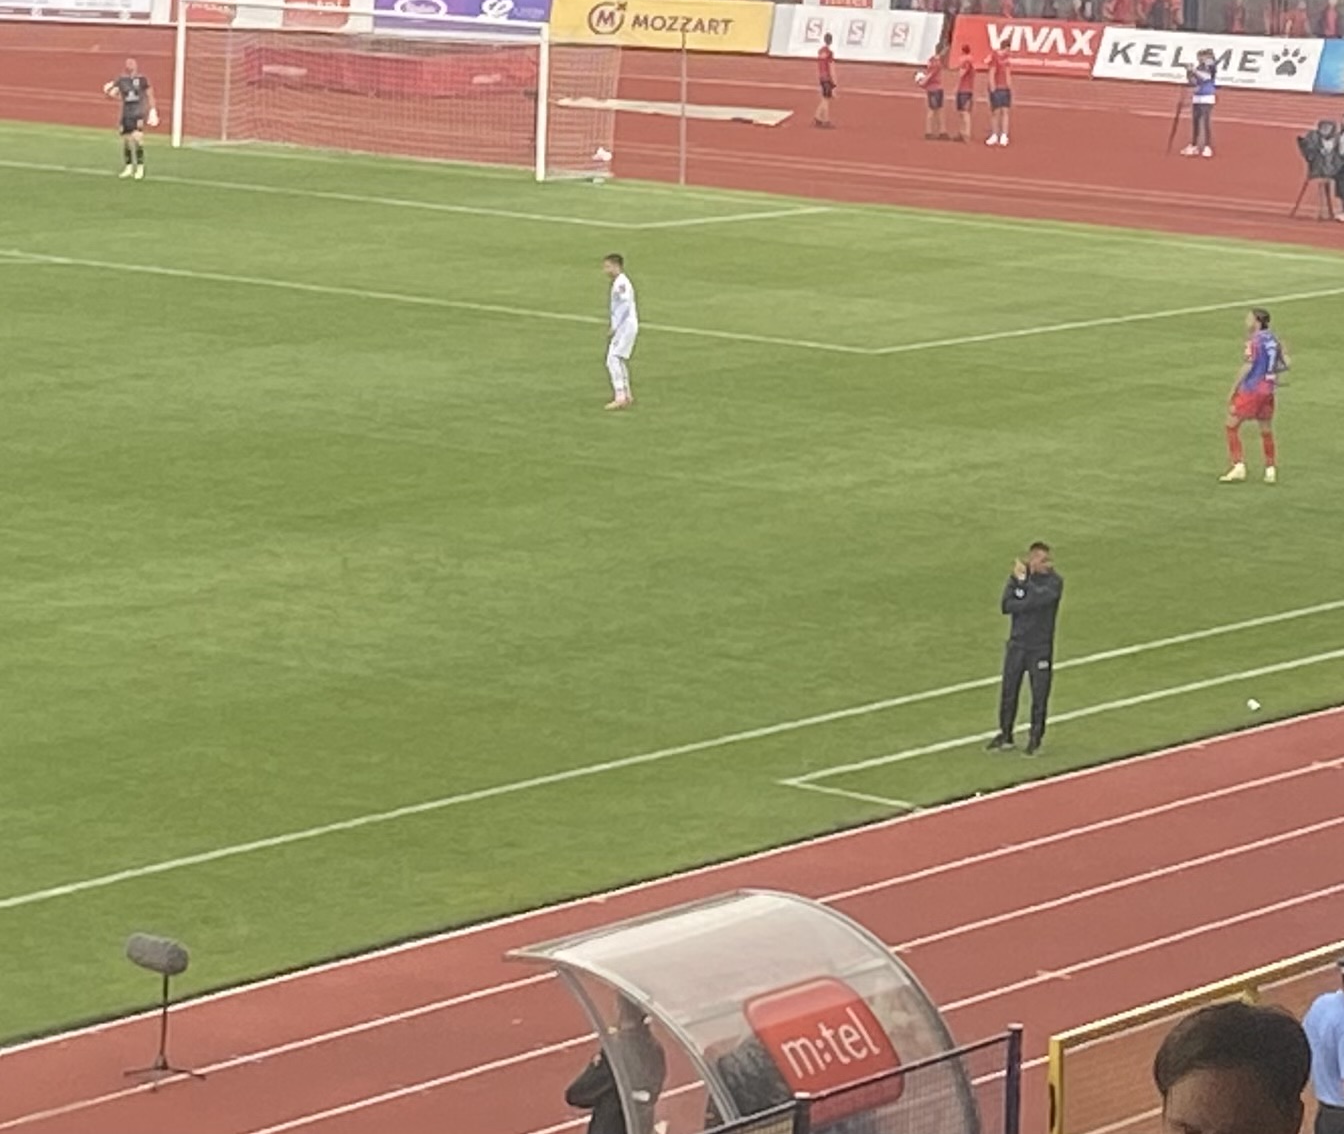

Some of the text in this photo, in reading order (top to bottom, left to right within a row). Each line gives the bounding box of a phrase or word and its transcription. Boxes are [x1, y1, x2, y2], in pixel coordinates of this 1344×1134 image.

[631, 13, 734, 35] MOZZART
[987, 22, 1096, 56] VIVAX
[780, 1005, 881, 1080] m:tel
